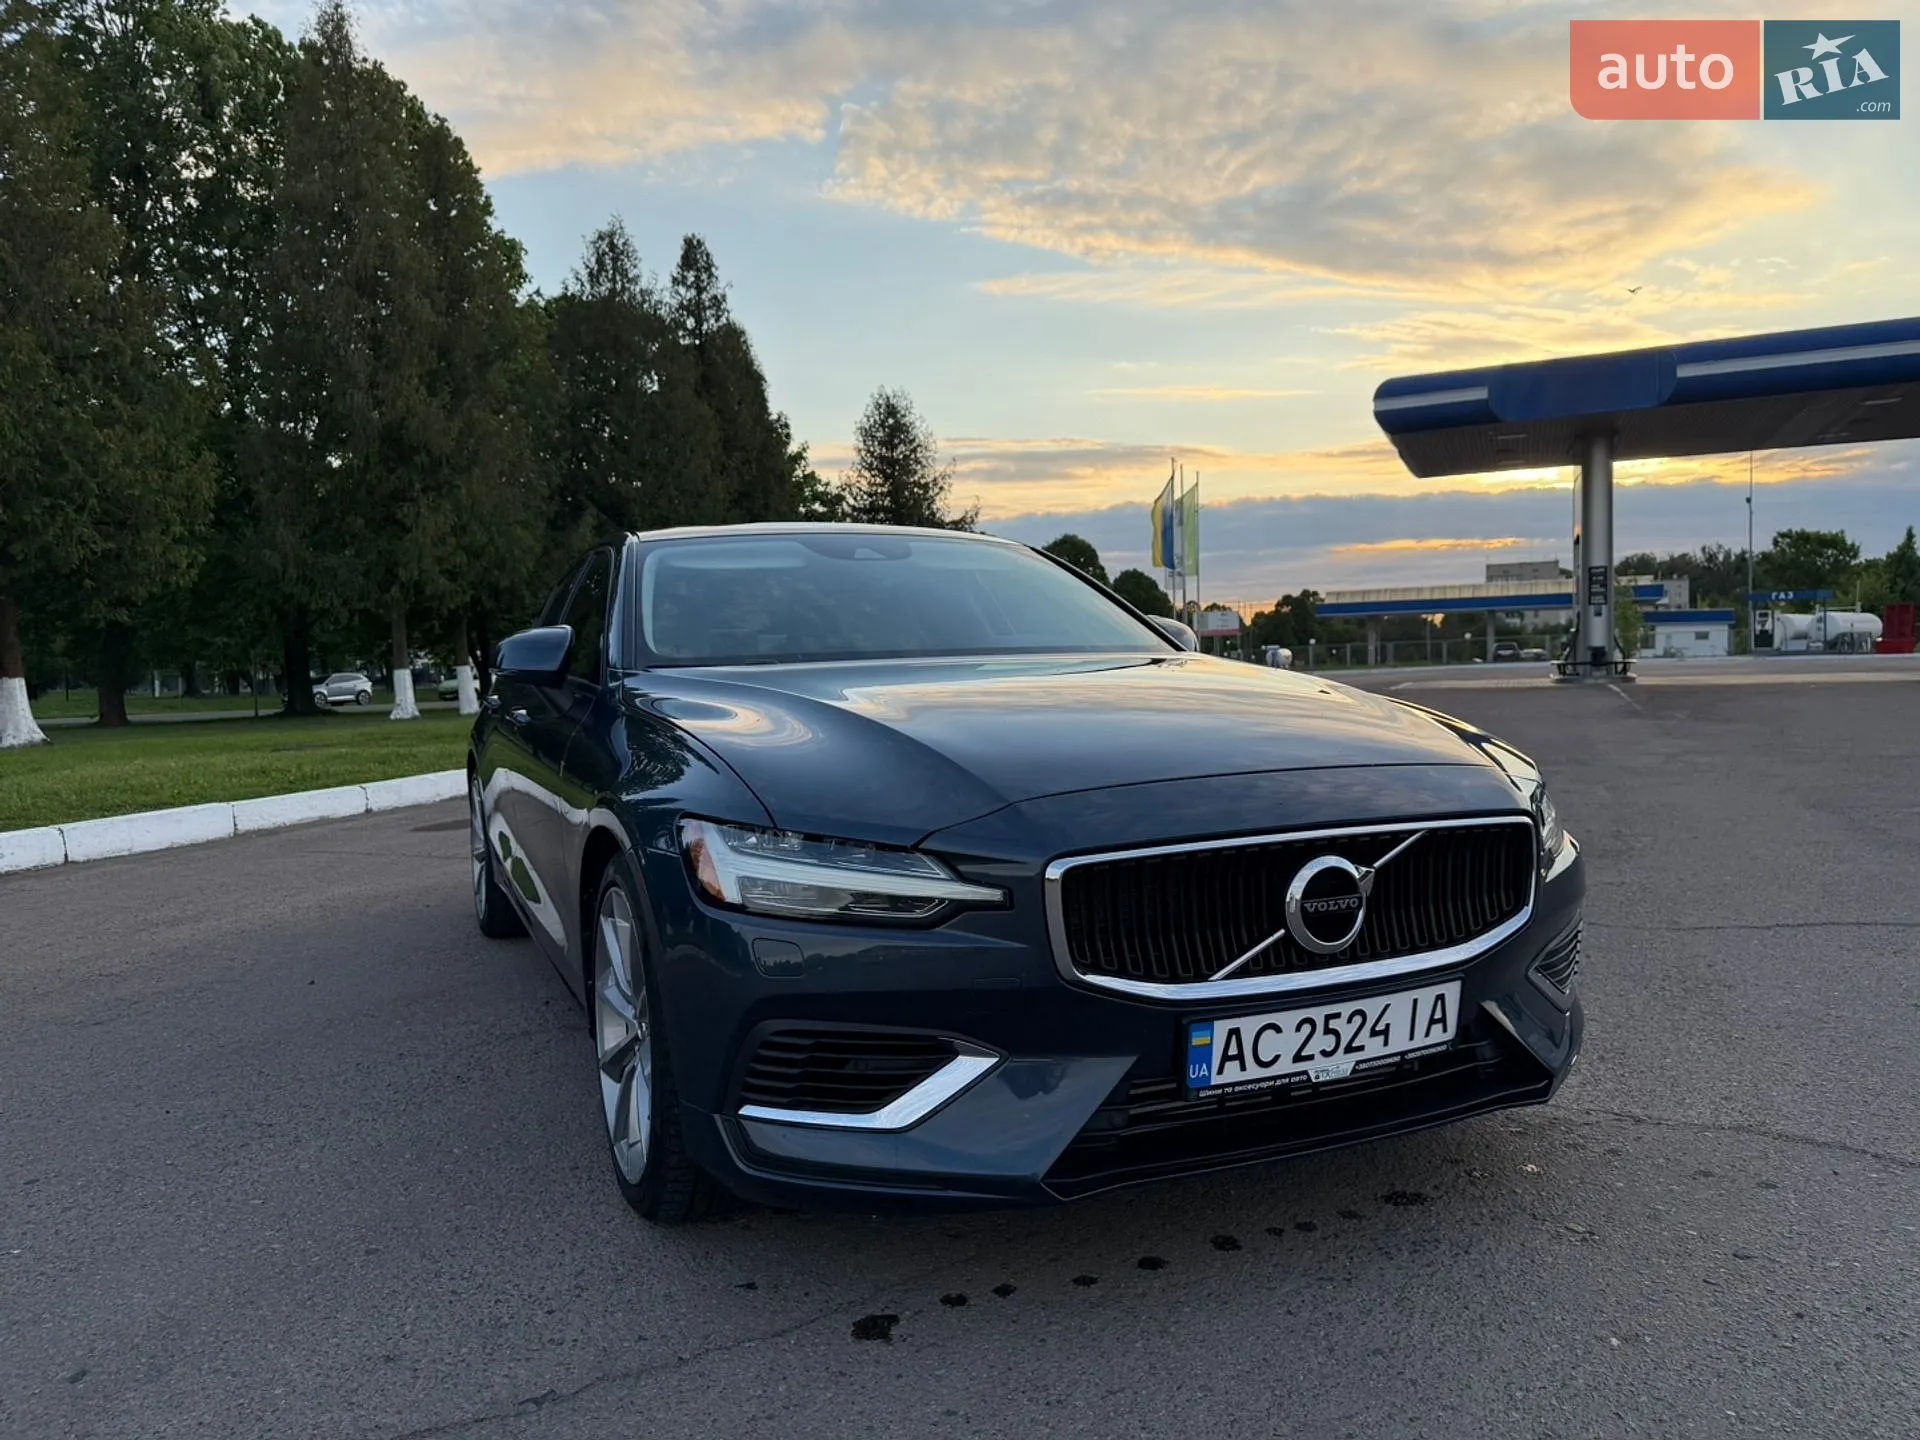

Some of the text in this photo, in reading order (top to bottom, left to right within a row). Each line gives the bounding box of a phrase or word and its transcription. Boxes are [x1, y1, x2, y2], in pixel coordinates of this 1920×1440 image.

[1771, 591, 1794, 601] ГАЗ
[1303, 898, 1359, 912] VOLVO
[1215, 993, 1448, 1076] AC 2524 IA
[1189, 1063, 1209, 1079] UA
